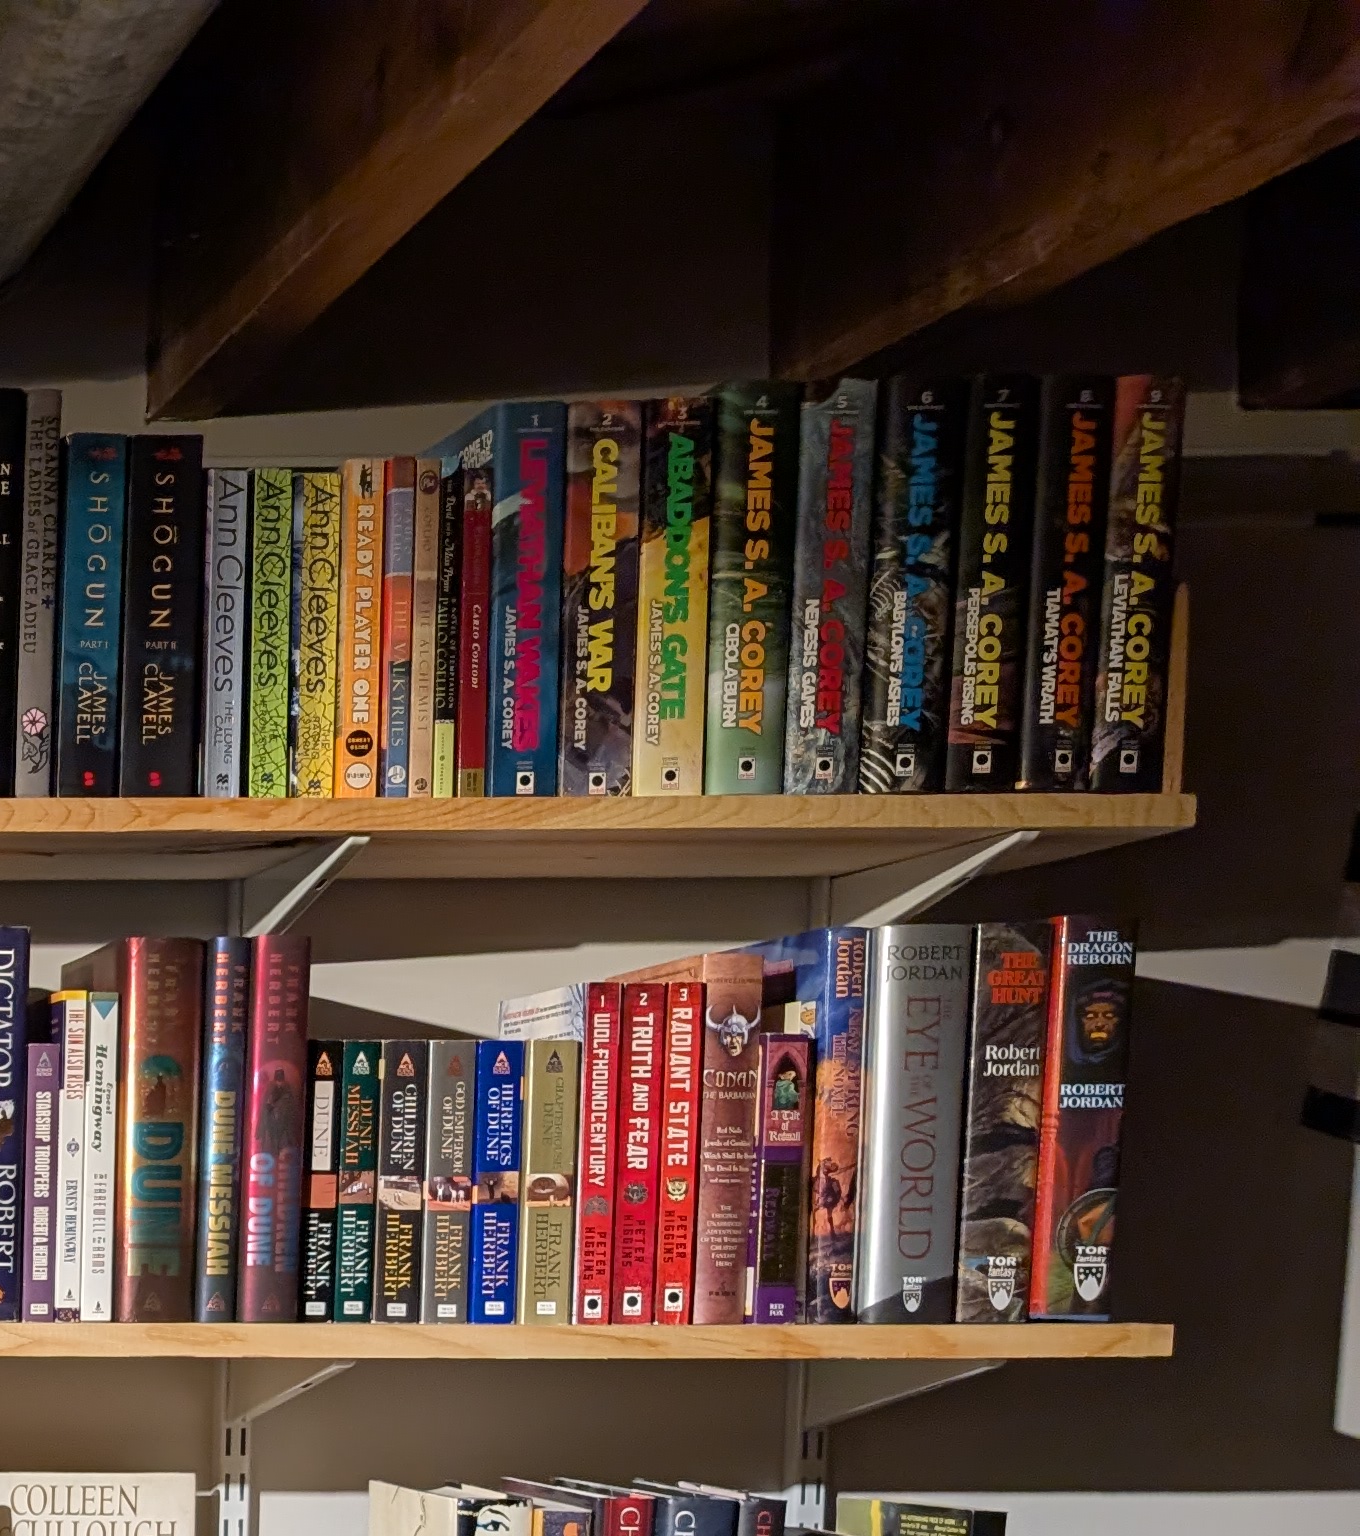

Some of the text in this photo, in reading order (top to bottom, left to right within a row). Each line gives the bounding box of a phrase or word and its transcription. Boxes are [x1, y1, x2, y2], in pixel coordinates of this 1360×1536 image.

[352, 505, 374, 724] READY PLAYER ONE
[586, 438, 620, 693] CALIBAN'S WAR
[1105, 574, 1130, 723] LEVIATHAN FALLS
[1067, 953, 1132, 966] REBORN
[1068, 942, 1133, 954] DRAGON
[1086, 931, 1117, 942] THE
[627, 1012, 653, 1170] TRUTH AND FEAR
[668, 1008, 691, 1166] RADIANT STATE
[10, 1485, 139, 1516] COLLEEN
